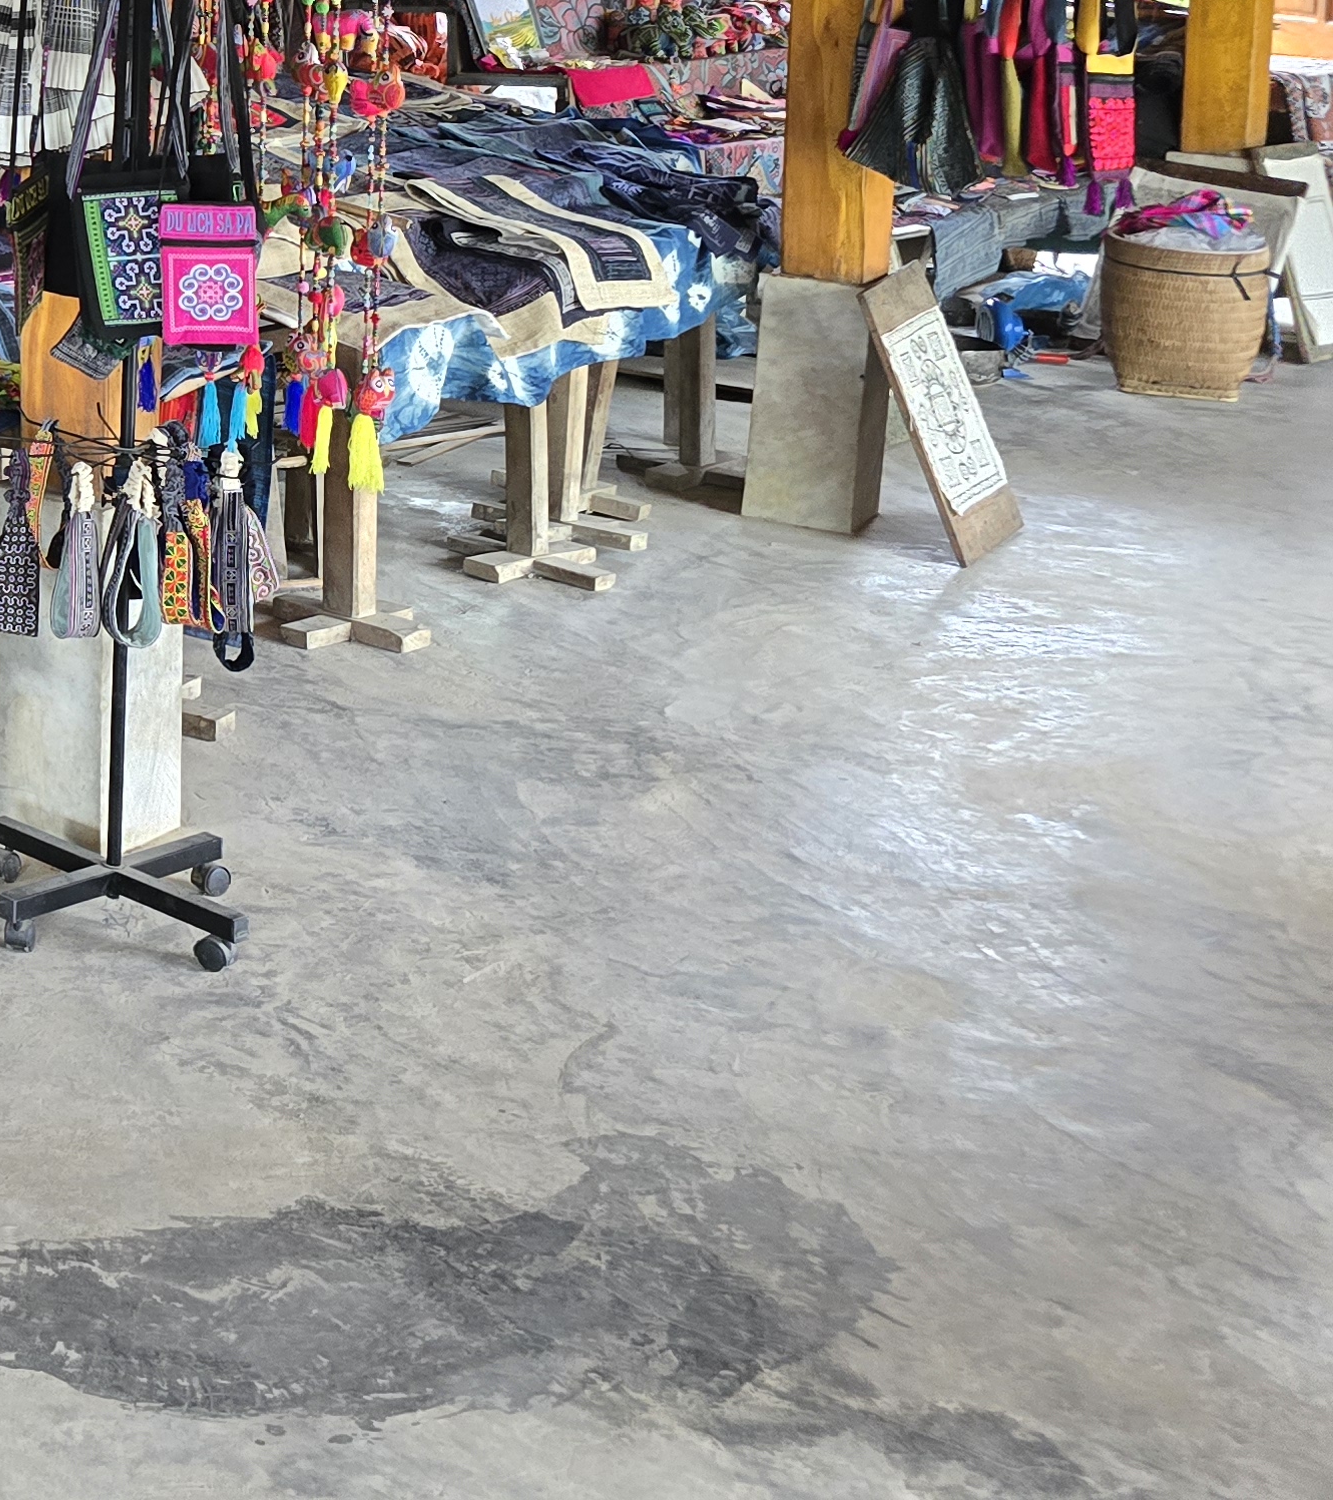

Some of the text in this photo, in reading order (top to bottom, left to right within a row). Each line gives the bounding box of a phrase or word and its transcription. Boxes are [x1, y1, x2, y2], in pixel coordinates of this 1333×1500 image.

[166, 211, 183, 232] DU
[216, 212, 233, 234] SA
[236, 211, 253, 235] PA
